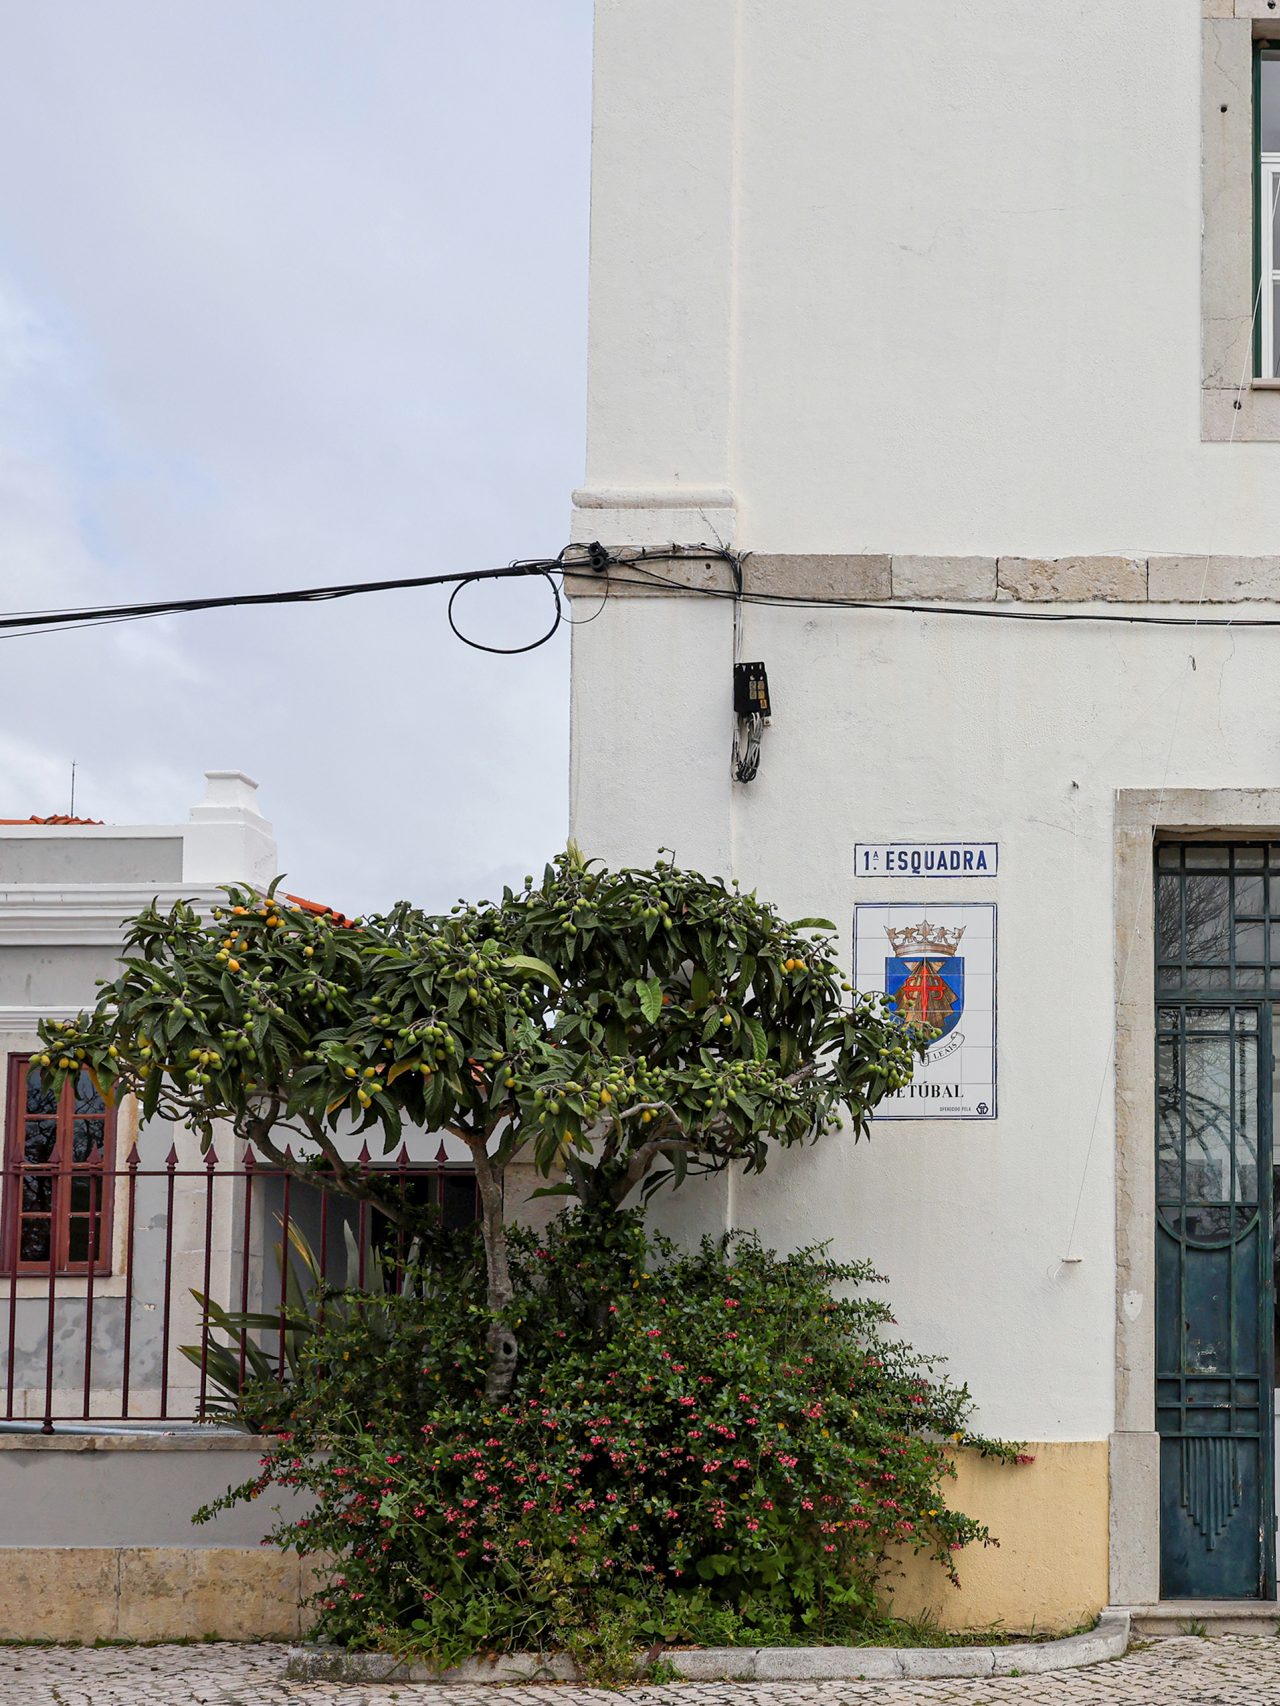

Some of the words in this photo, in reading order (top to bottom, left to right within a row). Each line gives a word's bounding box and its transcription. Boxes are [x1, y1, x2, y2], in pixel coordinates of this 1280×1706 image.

[886, 850, 988, 874] ESQUADRA
[933, 1042, 957, 1059] LEAIS
[884, 1081, 964, 1098] ETÚBAL
